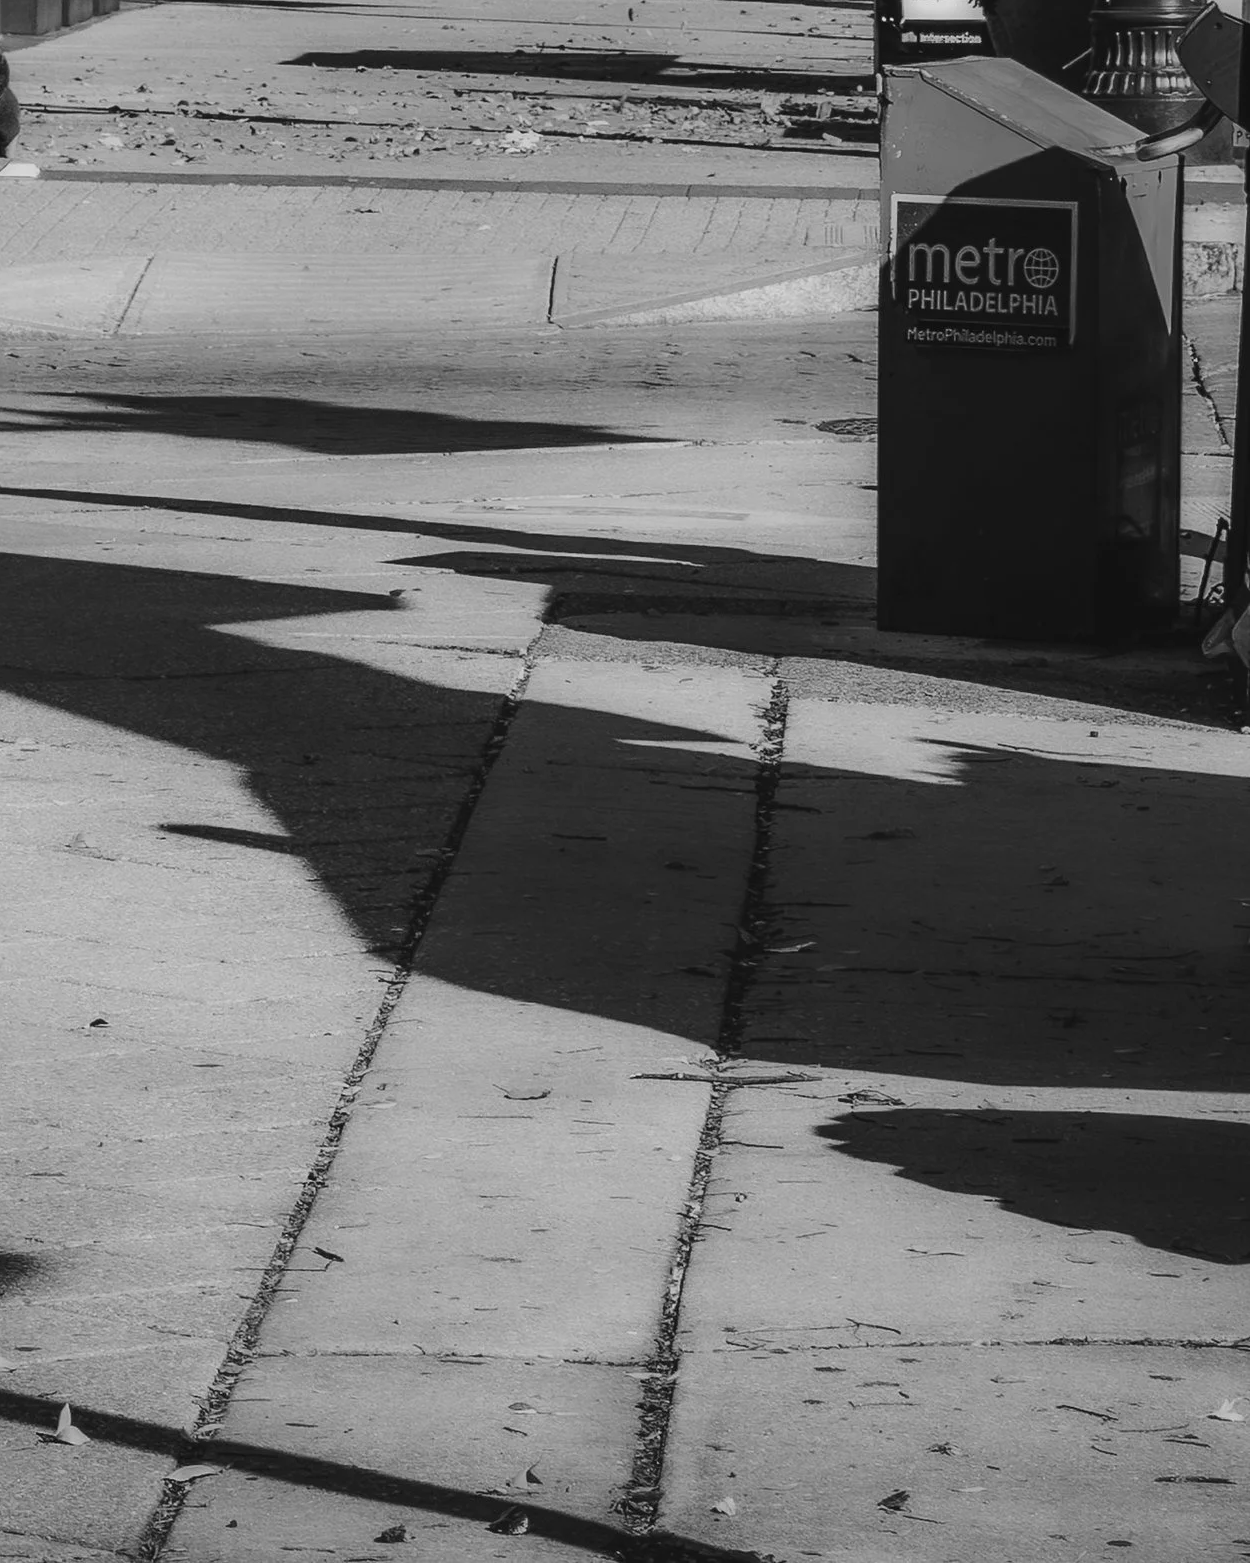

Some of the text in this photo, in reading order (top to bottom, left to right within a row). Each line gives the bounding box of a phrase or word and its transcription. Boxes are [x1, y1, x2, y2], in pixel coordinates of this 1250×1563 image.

[908, 238, 1059, 288] metro
[908, 289, 1058, 316] PHILADELPHIA
[907, 326, 1057, 348] MetroPhiladelphia.com
